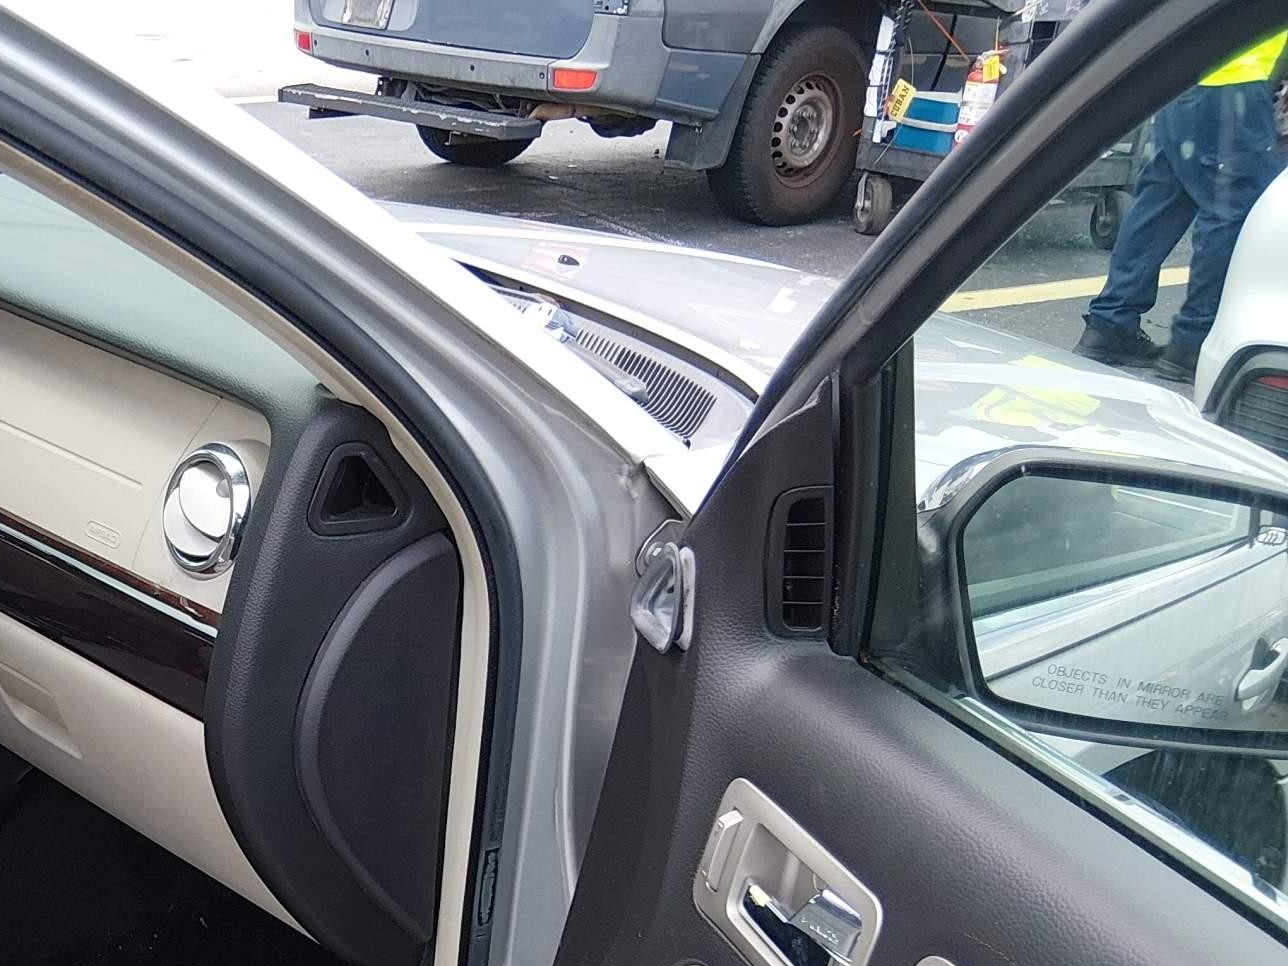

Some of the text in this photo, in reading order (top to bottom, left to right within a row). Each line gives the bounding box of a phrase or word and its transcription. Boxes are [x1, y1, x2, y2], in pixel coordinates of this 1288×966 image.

[890, 85, 911, 117] CUBAN
[1032, 676, 1229, 721] CLOSER THAN THEY APPEAR
[1047, 664, 1225, 706] OBJECTS IN MIRROR ARE
